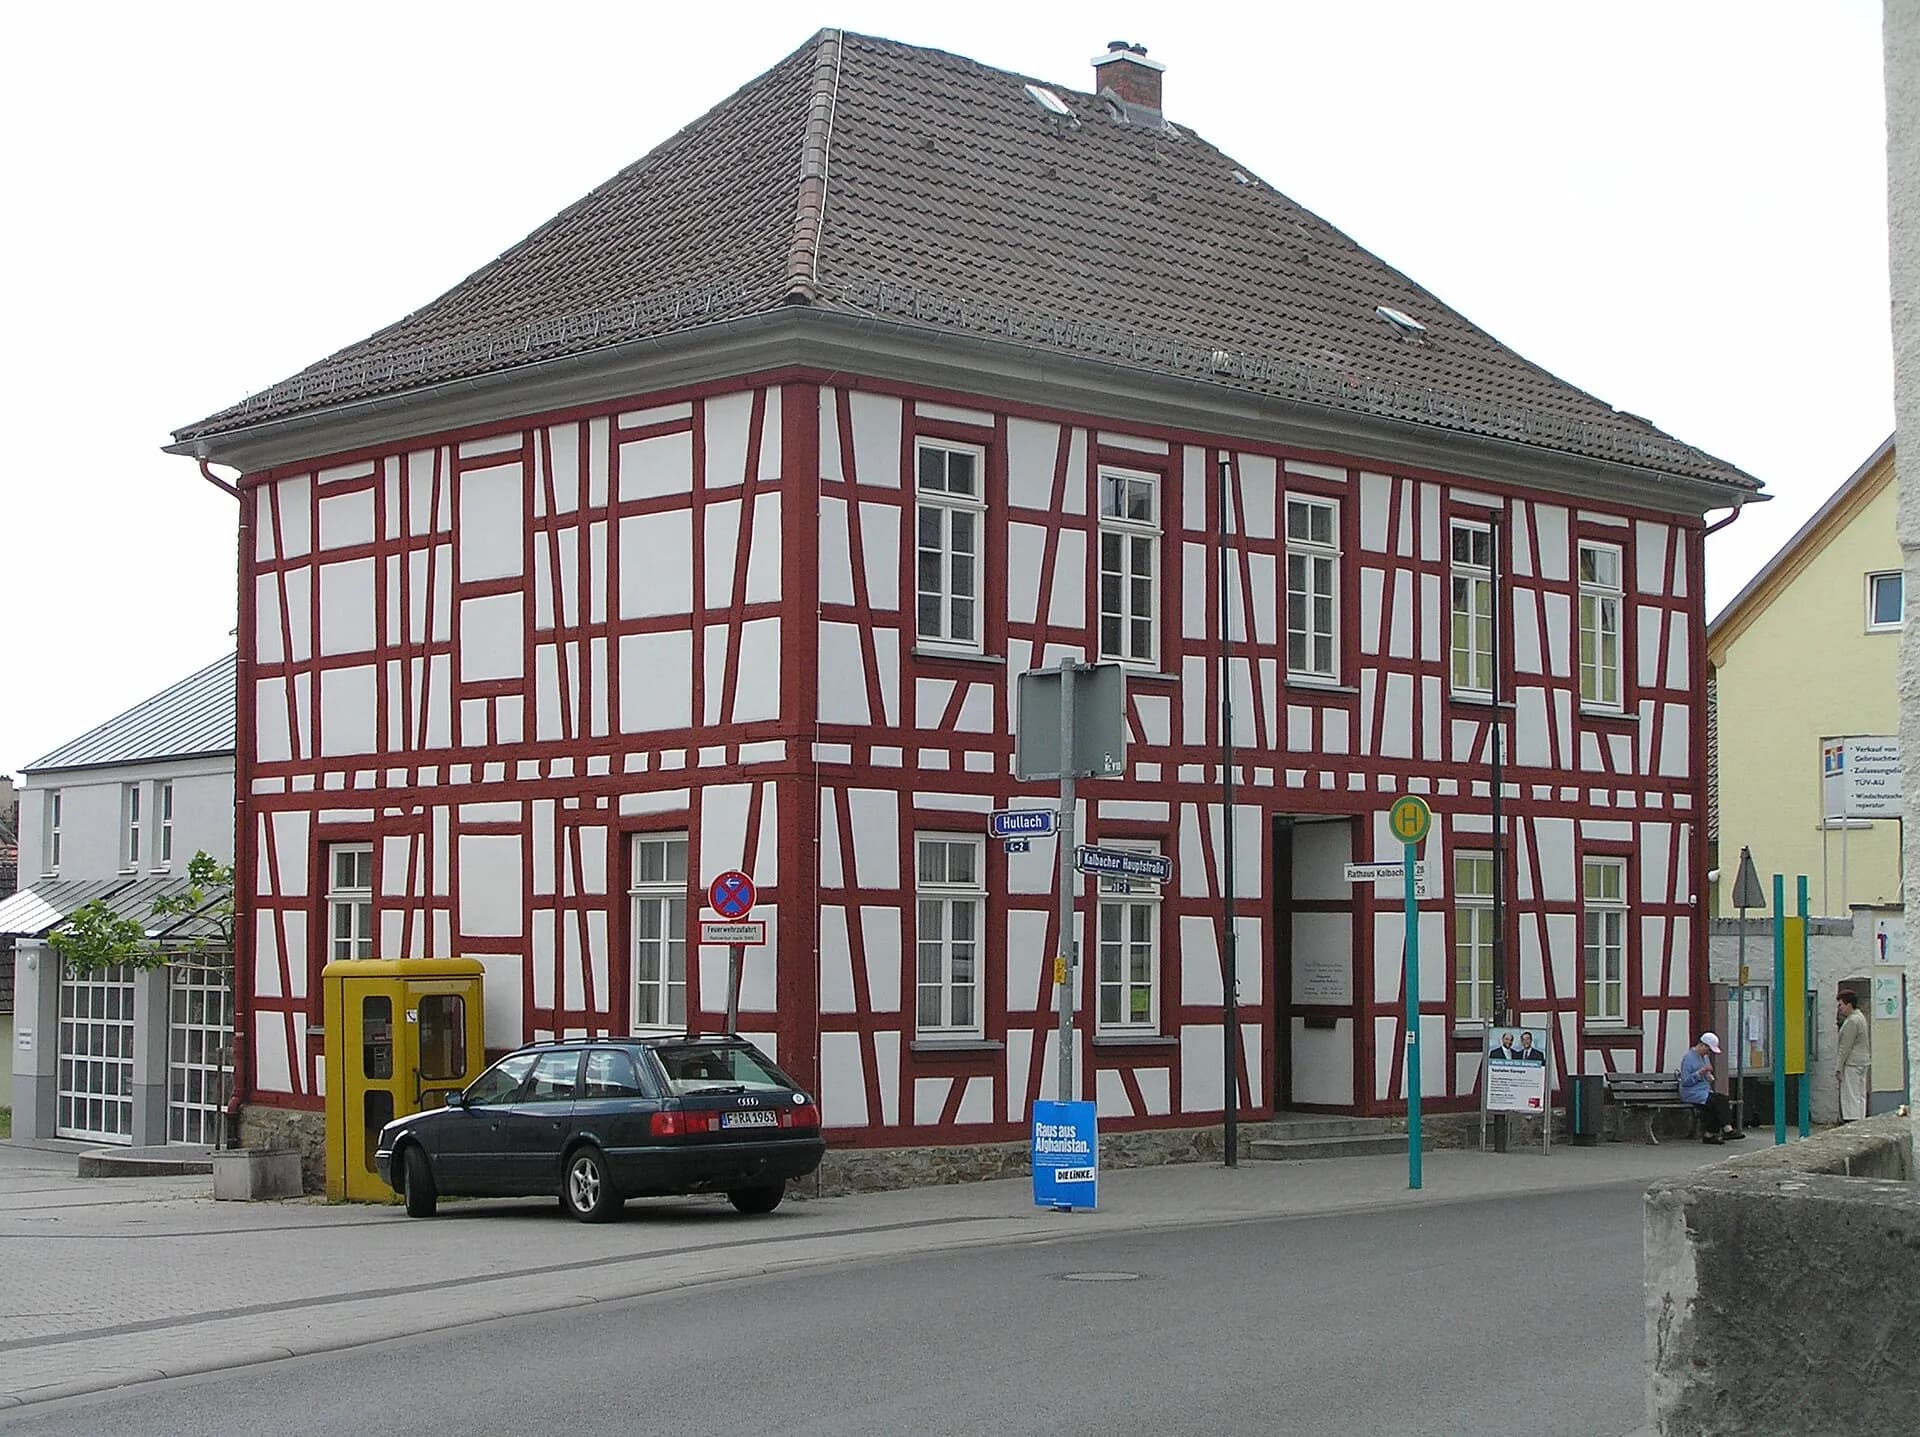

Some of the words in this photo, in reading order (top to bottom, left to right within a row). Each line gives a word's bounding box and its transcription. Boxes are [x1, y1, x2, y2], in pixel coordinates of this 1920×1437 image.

[1003, 815, 1042, 829] Hullach
[1402, 806, 1418, 833] H
[1084, 852, 1120, 869] Kalbacher
[1122, 857, 1164, 875] Hauptstraße
[1347, 870, 1375, 878] Rathaus
[1376, 868, 1404, 878] Kalbach
[707, 925, 757, 934] Feuerwehrzufahrt
[175, 959, 186, 983] 2
[726, 1113, 733, 1124] F
[739, 1112, 752, 1124] RA
[752, 1111, 775, 1123] 1963
[1035, 1122, 1058, 1138] Raus
[1058, 1124, 1076, 1138] aus
[1035, 1137, 1090, 1154] Afghanistan.
[1057, 1171, 1069, 1180] DIE
